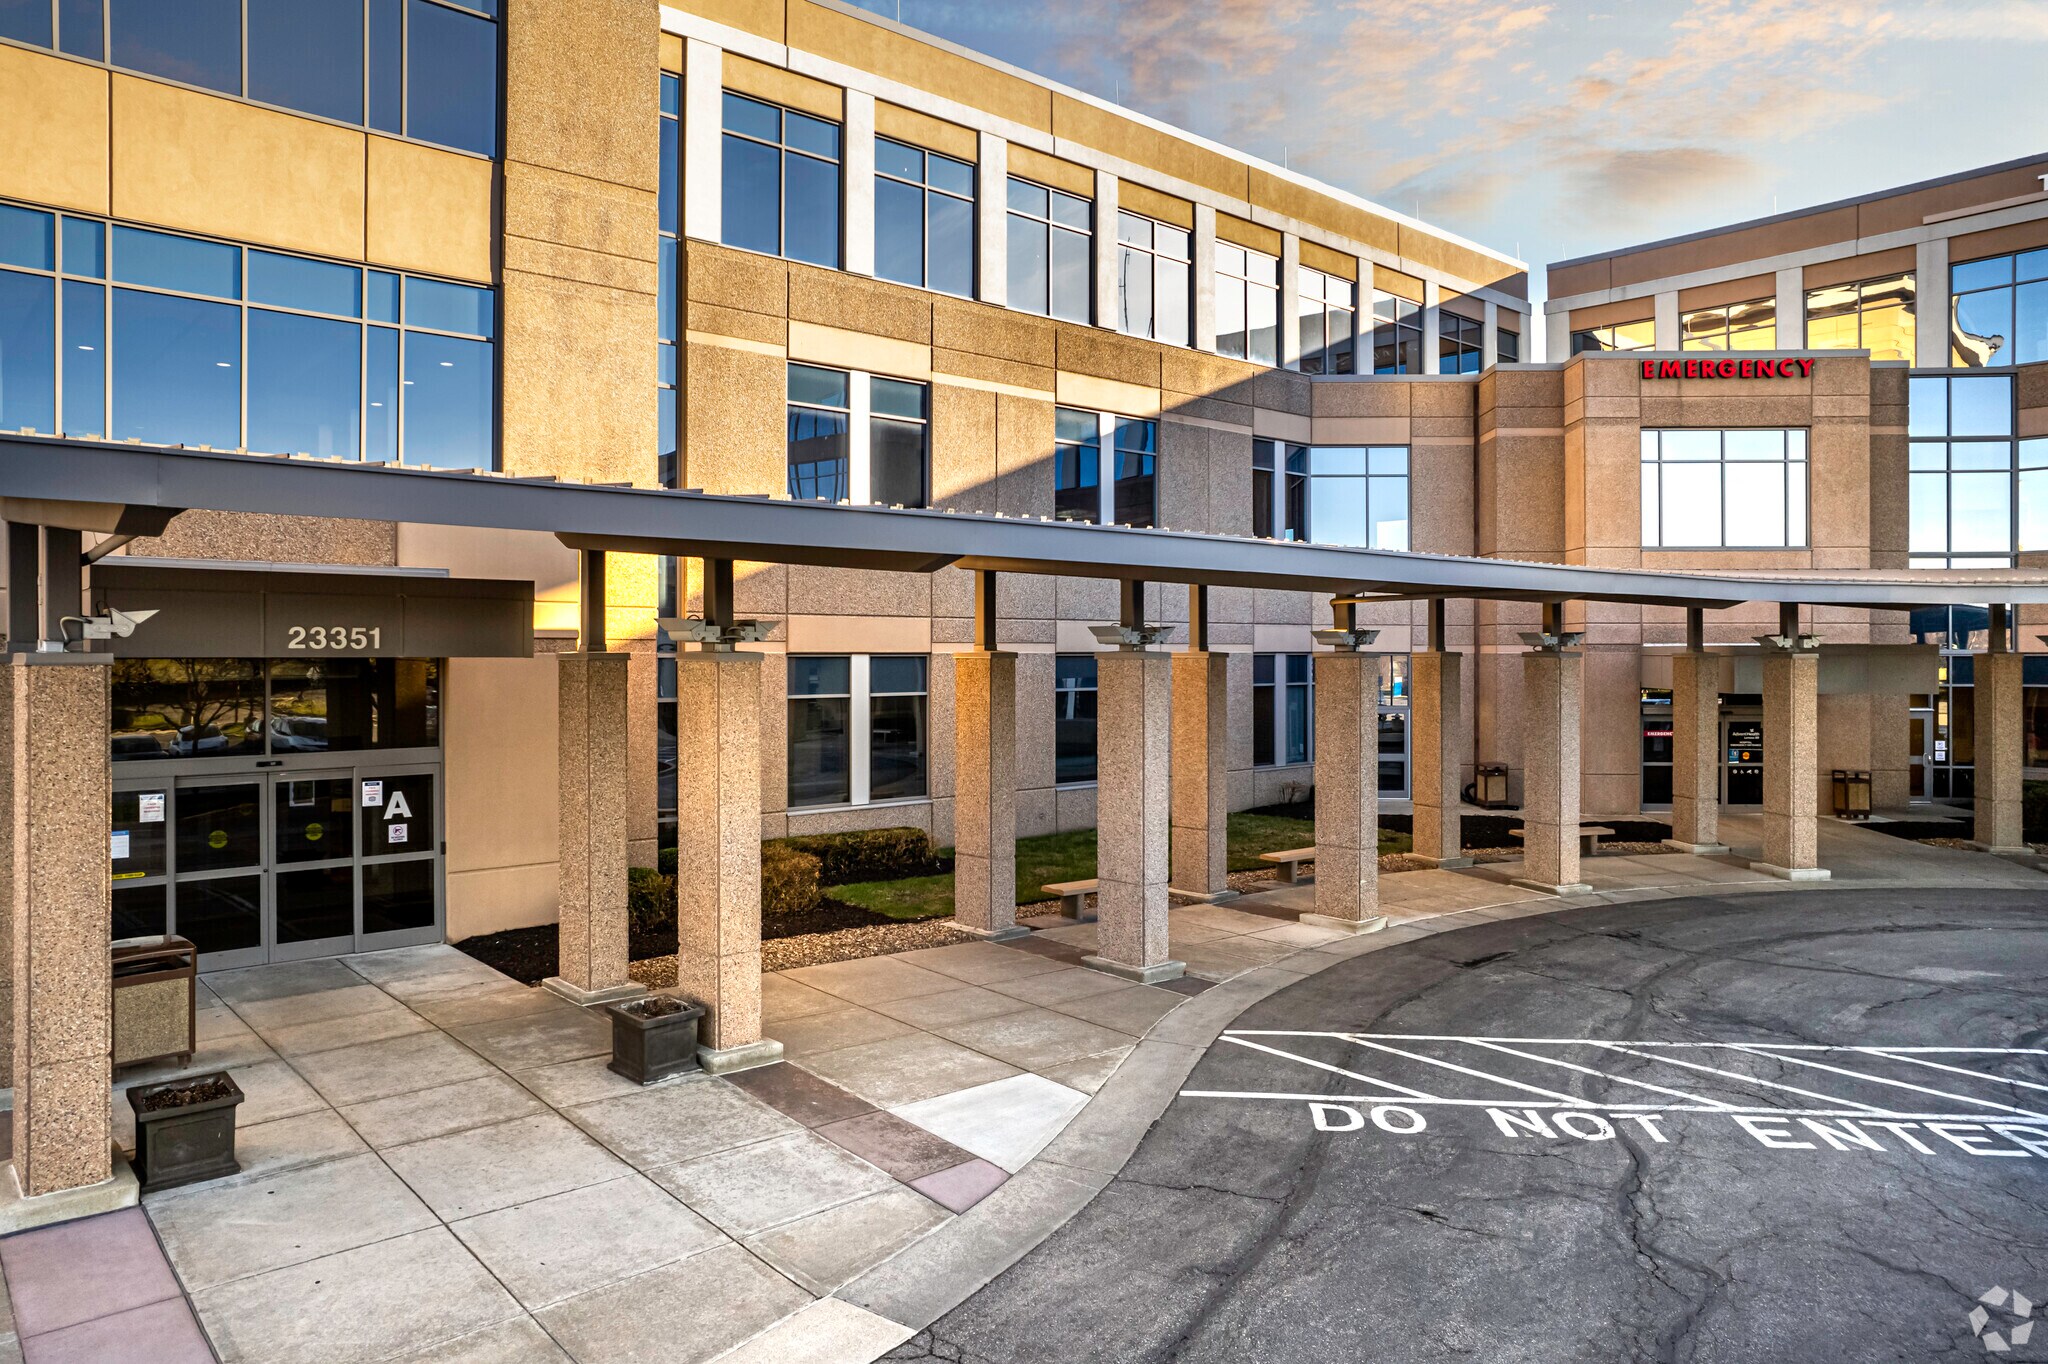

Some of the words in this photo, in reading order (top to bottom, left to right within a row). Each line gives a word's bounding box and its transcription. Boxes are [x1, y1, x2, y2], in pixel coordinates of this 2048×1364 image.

[1642, 358, 1815, 379] EMERGENCY
[288, 626, 380, 650] 23351
[383, 791, 413, 820] A
[1309, 1102, 1427, 1134] DO
[1485, 1107, 1670, 1143] NOT
[1731, 1114, 2048, 1159] ENTER
